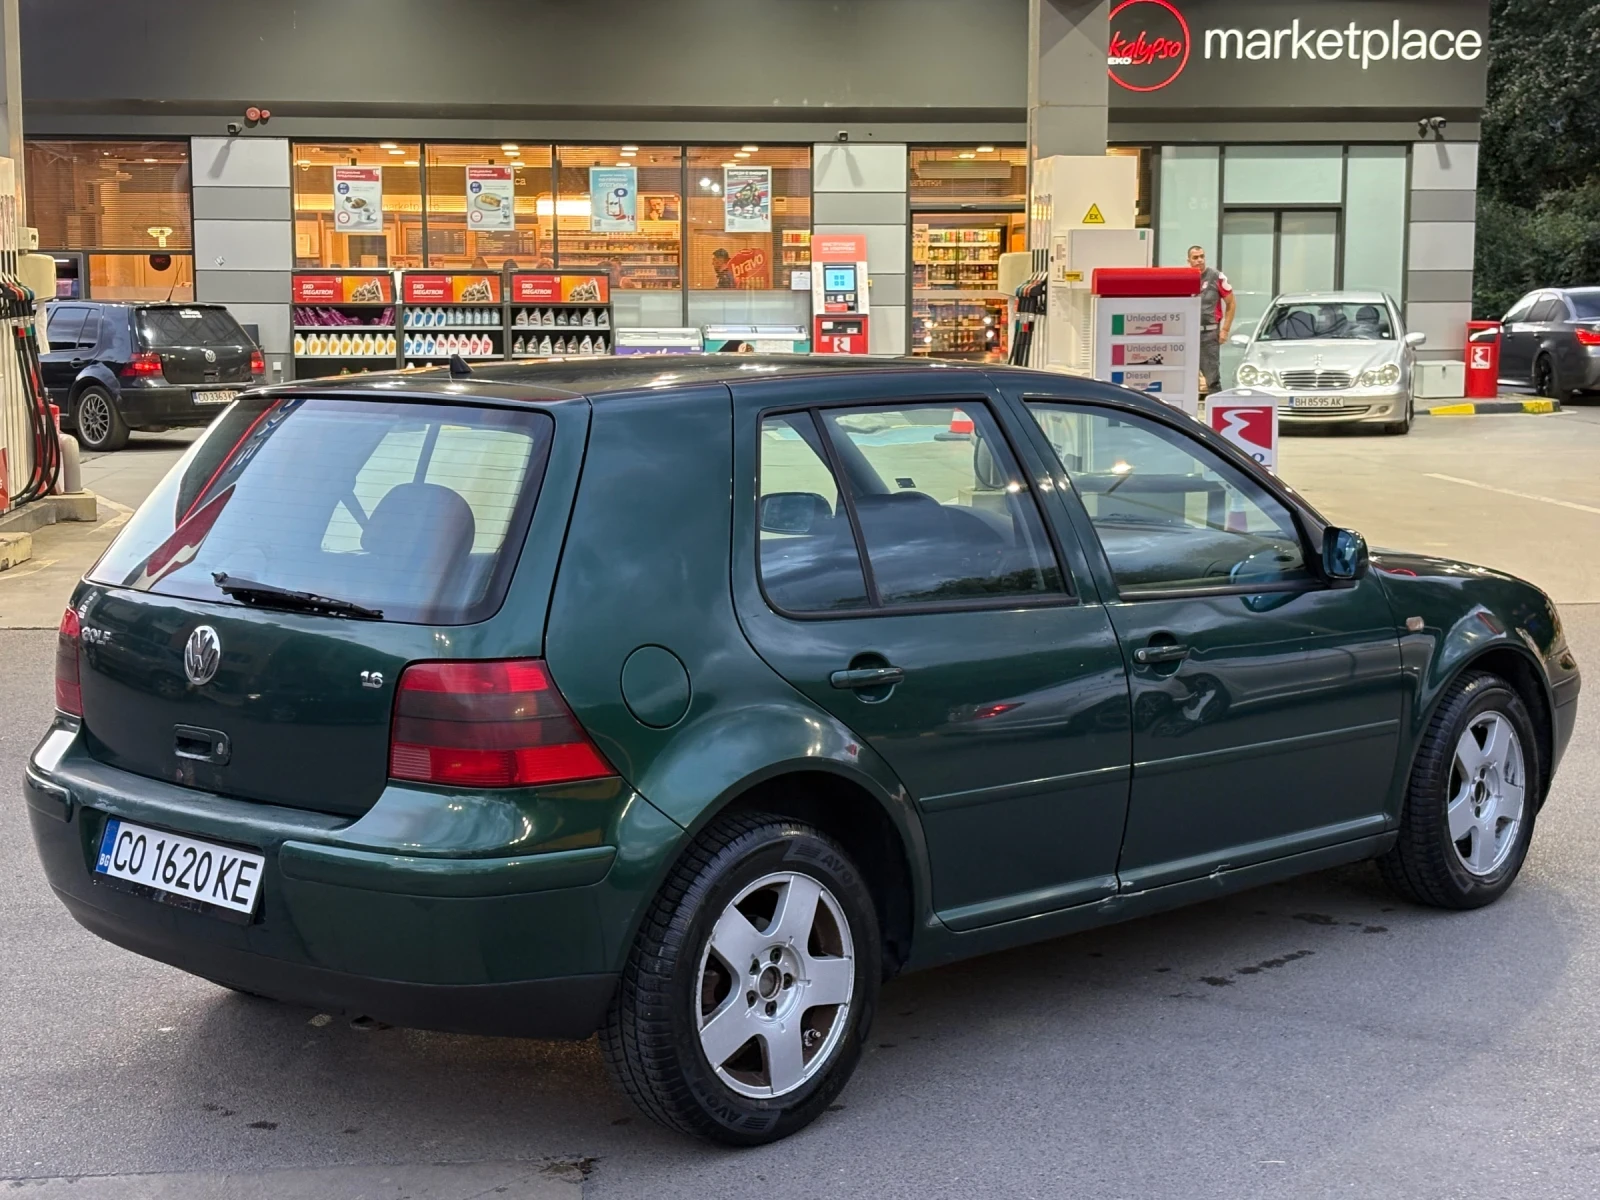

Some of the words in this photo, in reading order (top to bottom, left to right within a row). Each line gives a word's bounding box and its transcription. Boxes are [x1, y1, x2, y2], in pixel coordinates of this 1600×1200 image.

[1108, 31, 1182, 65] kalypso
[1204, 19, 1482, 69] marketplace
[1107, 57, 1132, 65] EKO
[731, 253, 764, 278] bravo
[1126, 314, 1167, 322] Unleaded
[1170, 314, 1180, 322] 95
[1126, 344, 1167, 352] Unleaded
[1170, 344, 1184, 352] 100
[1294, 398, 1307, 406] BH
[1308, 398, 1329, 406] 8595
[1330, 398, 1342, 406] AK
[81, 626, 112, 646] GOLF
[99, 853, 111, 867] BG
[113, 829, 146, 875] CO
[151, 839, 213, 893] 1620
[215, 855, 259, 906] KE
